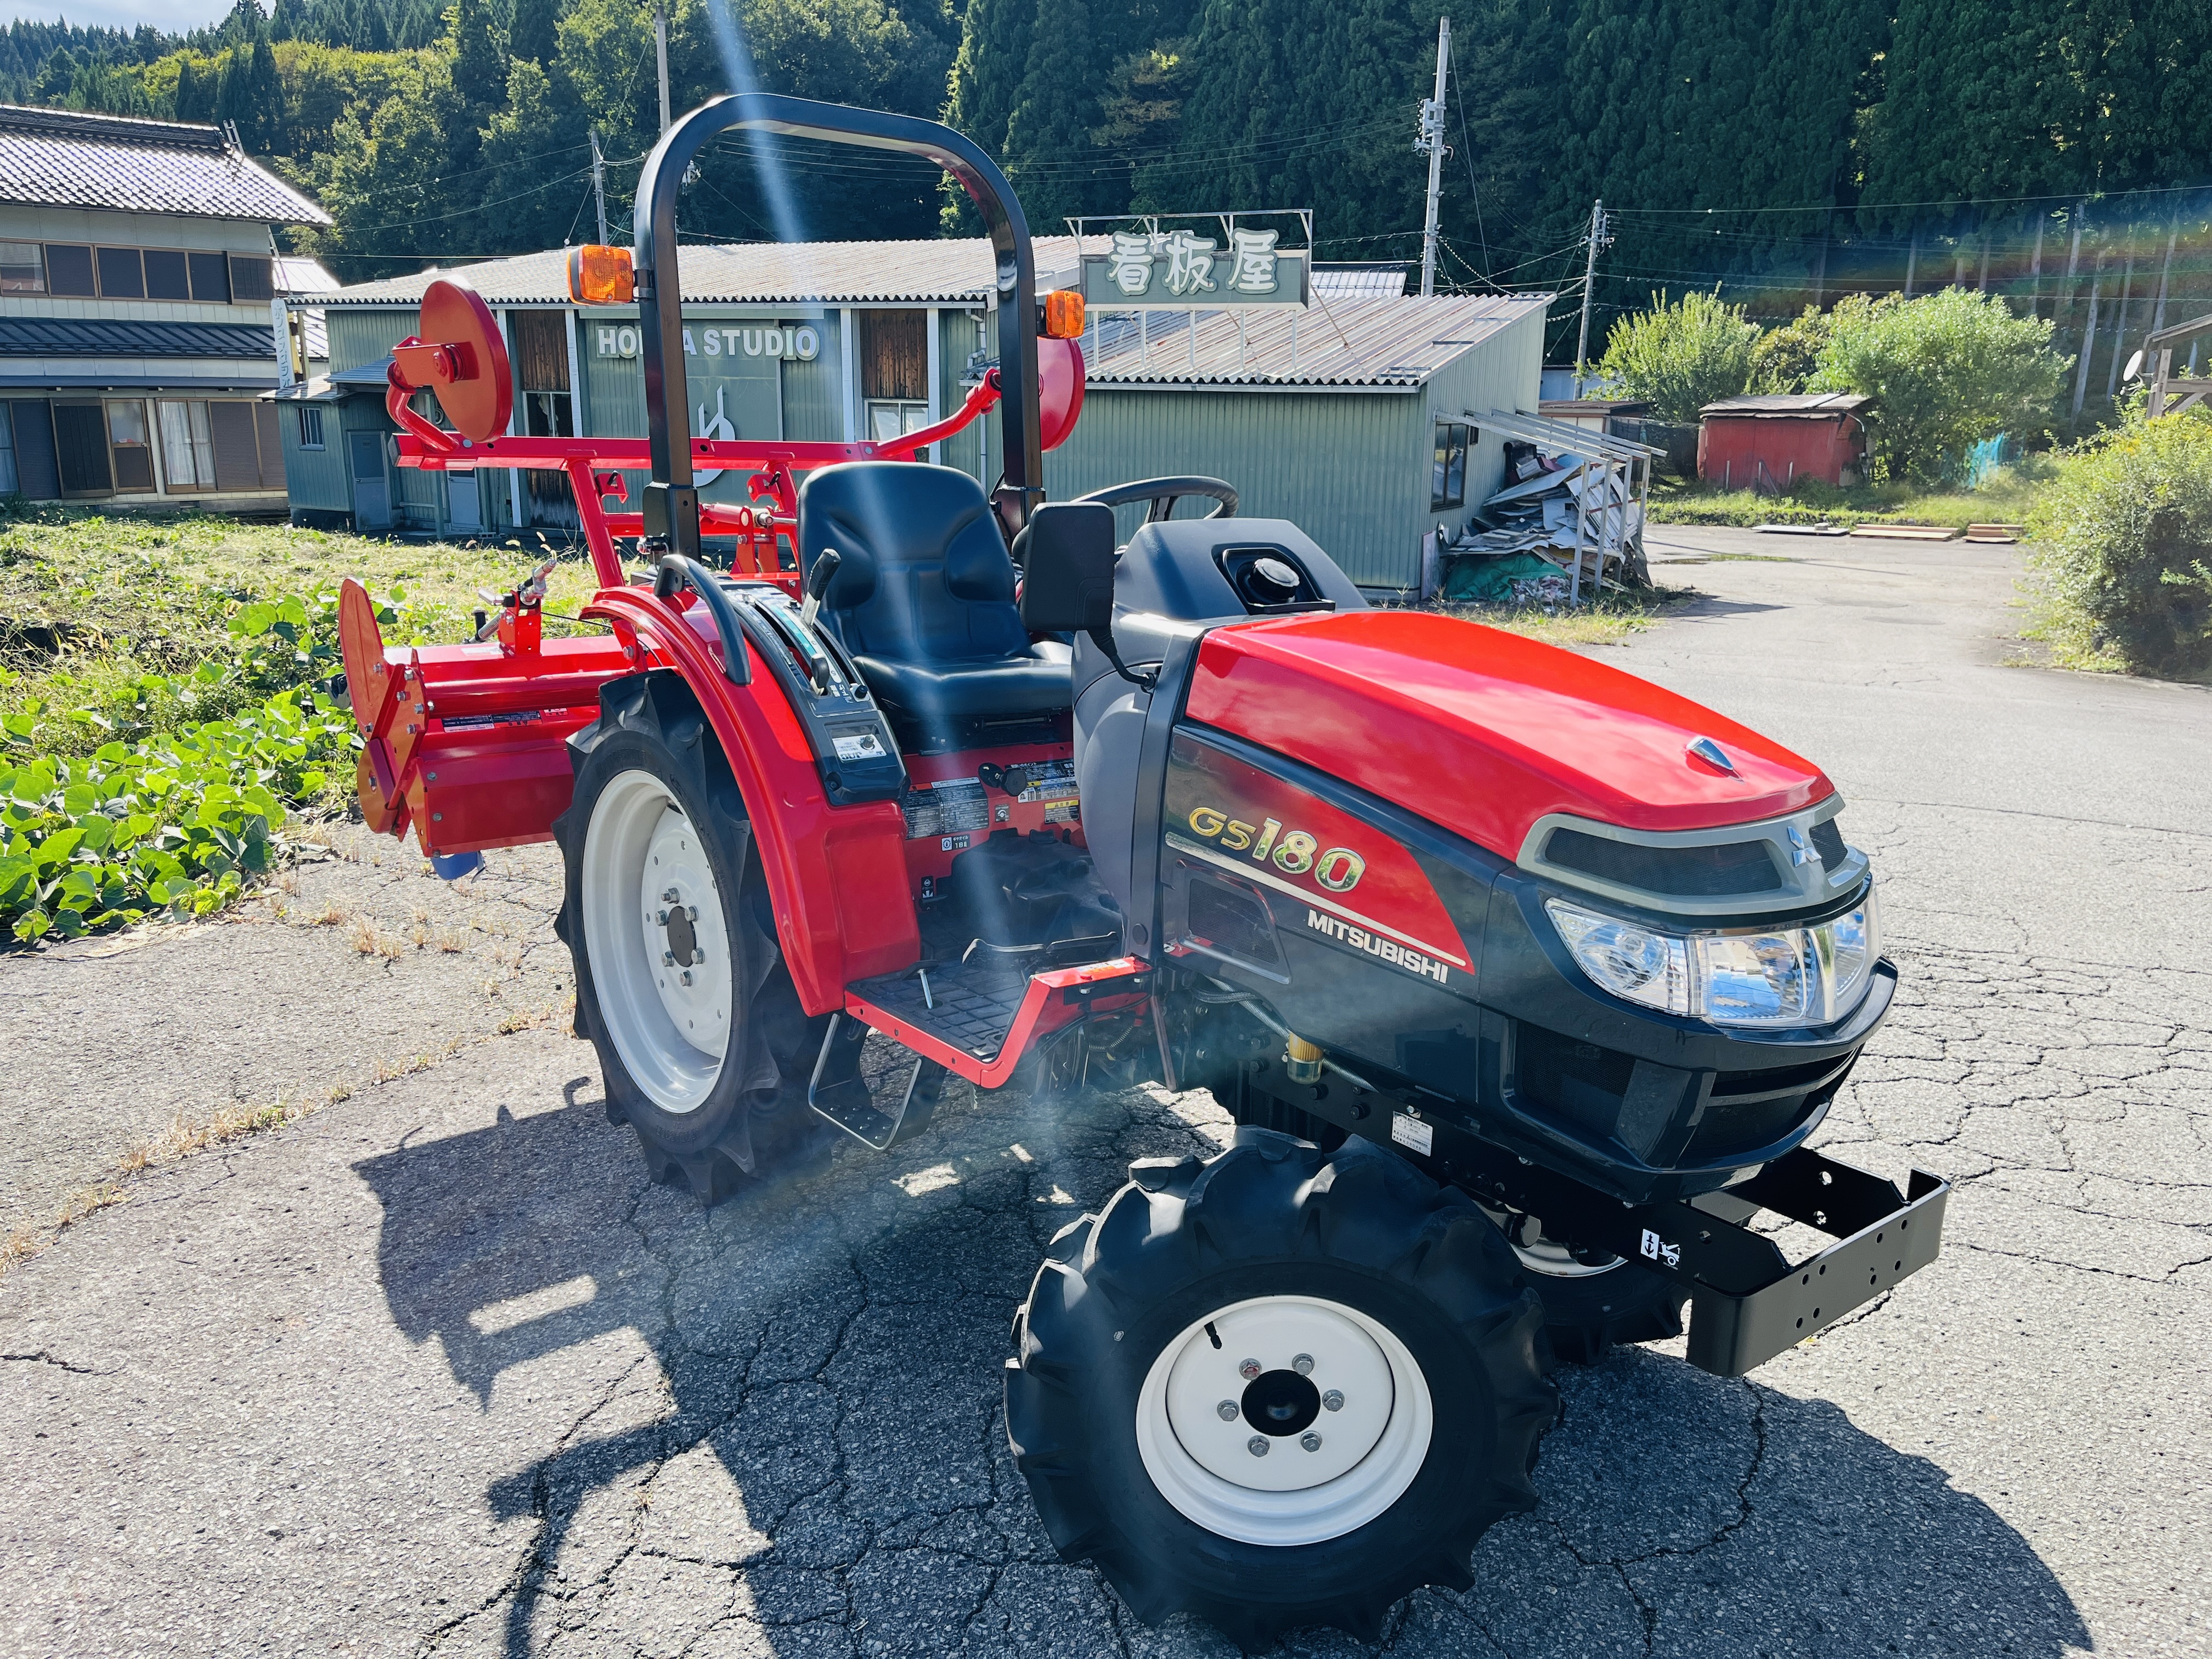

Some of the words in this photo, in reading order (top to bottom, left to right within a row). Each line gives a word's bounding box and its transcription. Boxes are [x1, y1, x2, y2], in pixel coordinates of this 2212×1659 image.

[1109, 232, 1276, 292] 看板屋
[597, 329, 697, 356] HOA
[703, 329, 817, 356] STUDIO
[1188, 806, 1366, 893] GS180
[1307, 909, 1449, 985] MITSUBISHI
